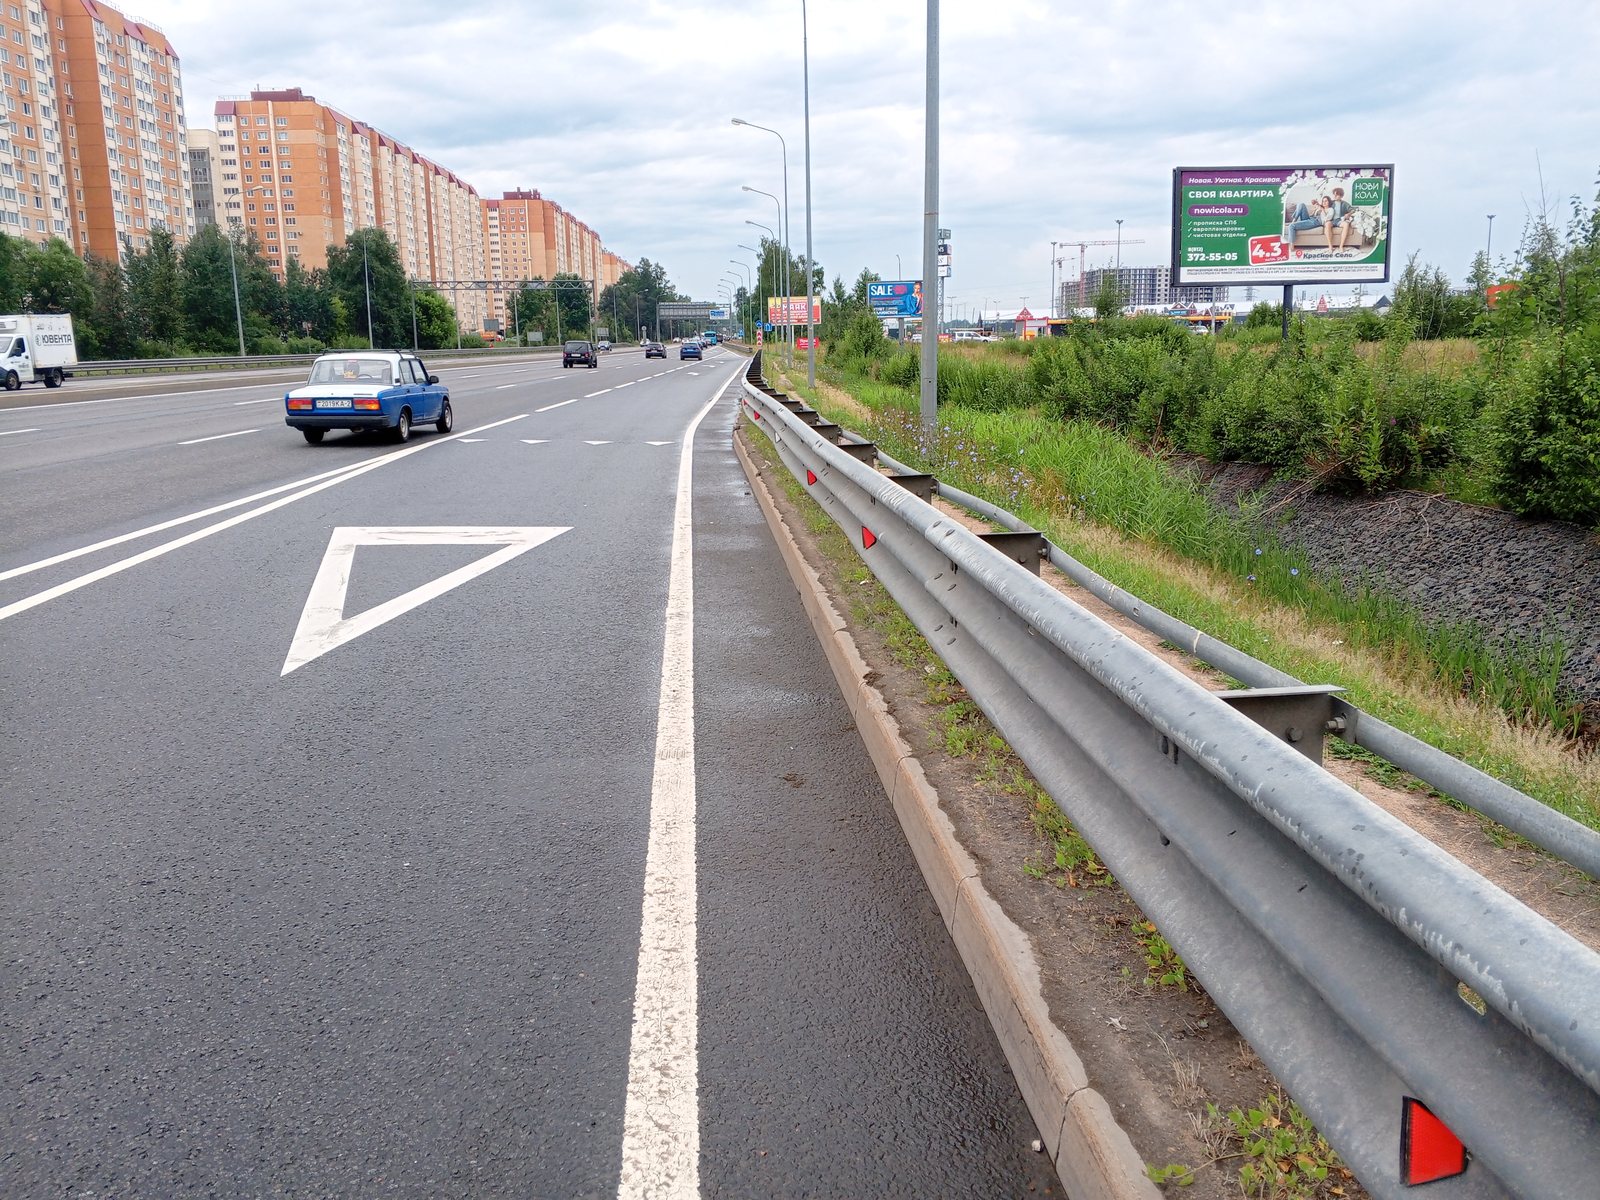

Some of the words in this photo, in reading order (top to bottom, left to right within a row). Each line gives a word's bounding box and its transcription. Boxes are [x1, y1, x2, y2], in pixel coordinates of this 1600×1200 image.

[1355, 182, 1379, 190] НОВИ
[1188, 190, 1216, 198] СВОЯ
[1219, 190, 1274, 198] КВАРТИРА
[1354, 191, 1379, 199] КОЛА
[1194, 206, 1243, 214] nowicola.ru
[1252, 242, 1282, 258] 4.3
[1187, 252, 1238, 261] 372-55-05
[1303, 252, 1332, 260] Красное
[870, 285, 893, 296] SALE
[41, 334, 72, 343] ЮВЕНТА
